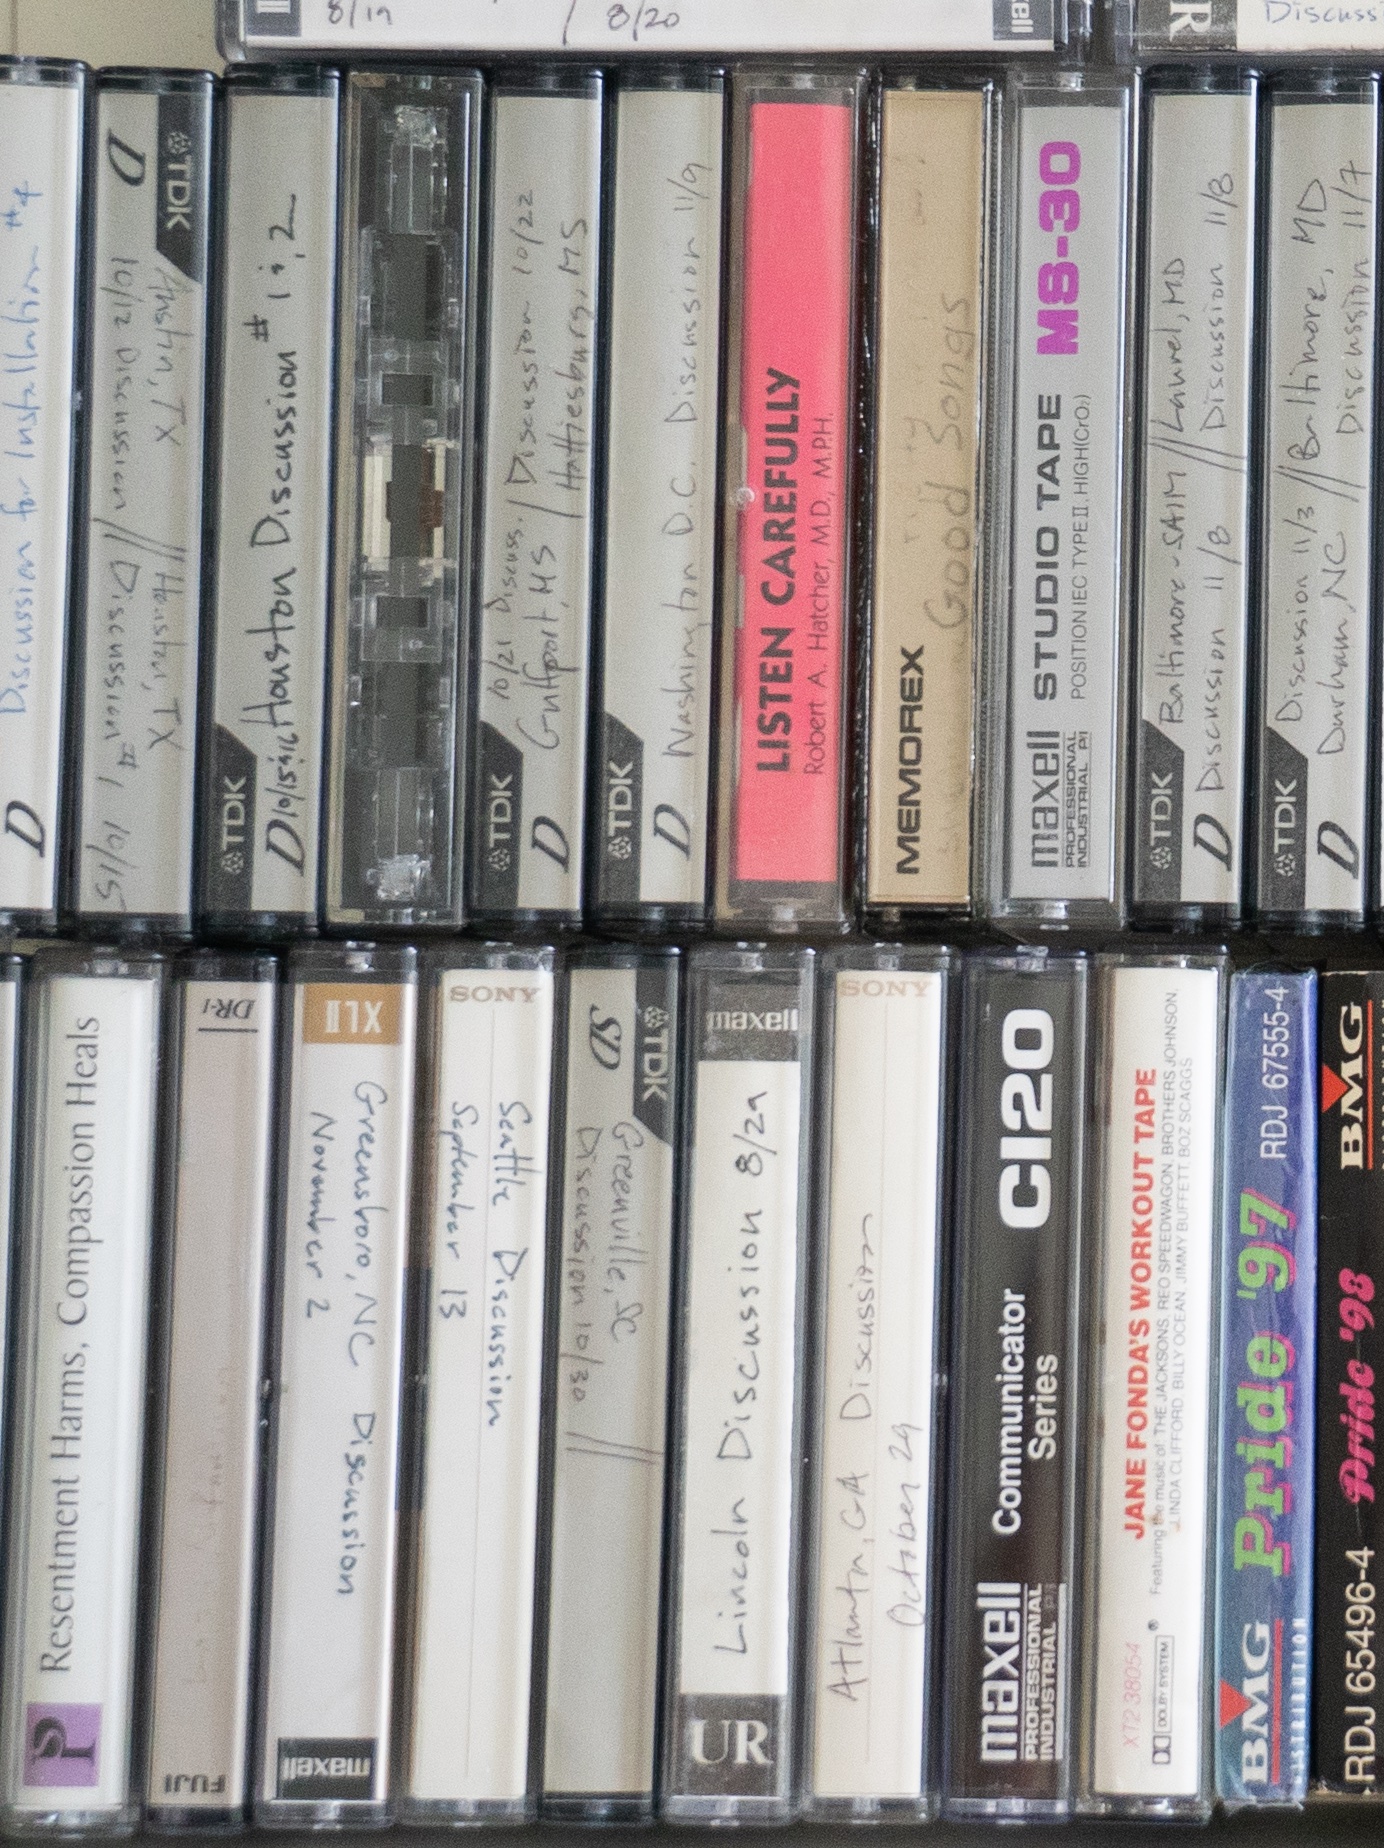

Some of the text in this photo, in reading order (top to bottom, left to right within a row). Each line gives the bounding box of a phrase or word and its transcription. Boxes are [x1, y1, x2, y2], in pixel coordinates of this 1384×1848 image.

[606, 0, 680, 41] 8/20
[1035, 140, 1082, 355] MS-30
[922, 290, 975, 453] Songs
[922, 480, 970, 629] Good
[1032, 392, 1062, 702] STUDIO TAPE
[1195, 172, 1243, 792] Discussion 11/8 Discussion 11/8
[756, 366, 800, 773] LISTEN CAREFULLY
[808, 558, 836, 651] Hatcher,
[804, 699, 829, 776] Robert
[806, 663, 827, 689] A.
[488, 774, 513, 848] TDK
[896, 643, 925, 876] MEMOREX
[1027, 729, 1061, 869] maxell
[1064, 730, 1079, 868] PROFESSIONAL
[531, 815, 570, 873] D
[448, 985, 542, 1003] SONY
[706, 1007, 799, 1034] maxell
[840, 979, 935, 997] SONY
[1163, 988, 1179, 1067] JOHNSON,
[1161, 1069, 1175, 1156] BROTHERS
[1179, 1057, 1194, 1123] SCAGGS
[1259, 986, 1290, 1159] RDJ 67555-4
[1338, 1003, 1364, 1170] BMG
[306, 1111, 336, 1319] November 2
[437, 1101, 478, 1318] September 13
[486, 1100, 542, 1426] Seattle Discussion
[40, 1015, 104, 1673] Resentment Harms, Compassion Heals
[335, 1081, 388, 1596] Greensboro, NC Discussion
[717, 1208, 763, 1460] Discussion
[1124, 1067, 1157, 1541] JANE FONDA'S WORKOUT TAPE
[1158, 1276, 1171, 1310] REO
[992, 1287, 1027, 1536] Communicator
[1028, 1353, 1060, 1461] Series
[1153, 1405, 1167, 1437] THE
[1233, 1187, 1297, 1576] Pride '97
[1337, 1267, 1376, 1504] Pride '98
[711, 1498, 751, 1655] Lincoln
[692, 1718, 773, 1765] UR
[975, 1582, 1022, 1762] maxell
[1023, 1582, 1043, 1760] PROFESSIONAL
[1122, 1640, 1143, 1702] 38054
[1242, 1620, 1270, 1785] BMG
[1344, 1545, 1377, 1783] RDJ 65496-4
[164, 1773, 227, 1795] FUJI
[283, 1757, 372, 1780] maxell
